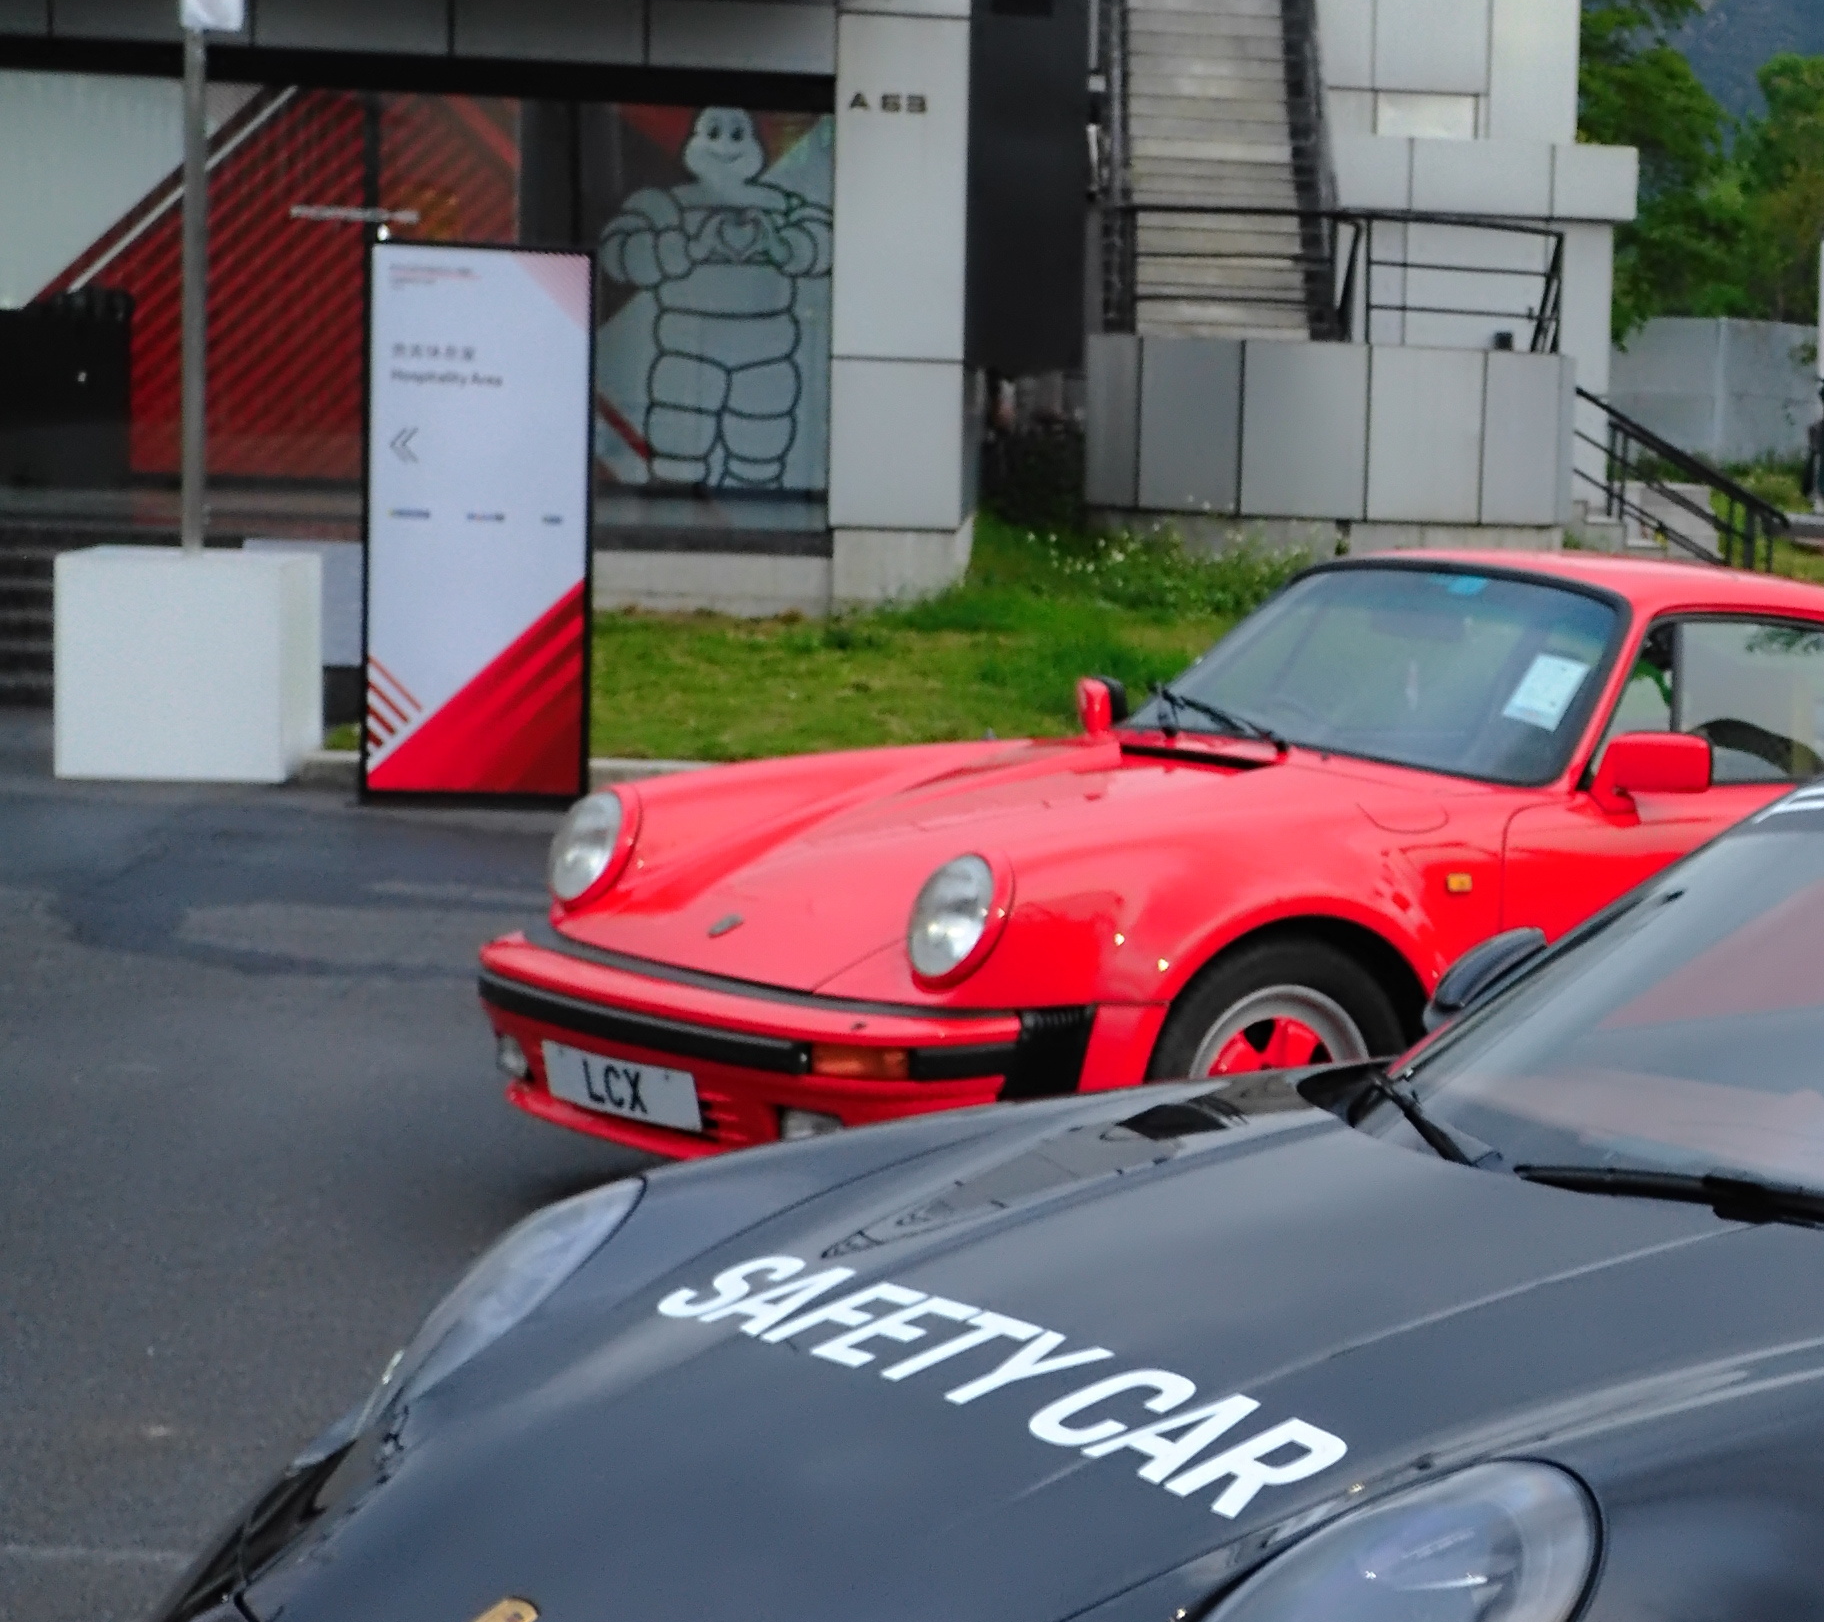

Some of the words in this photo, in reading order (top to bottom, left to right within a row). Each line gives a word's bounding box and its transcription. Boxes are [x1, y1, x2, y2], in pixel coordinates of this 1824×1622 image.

[581, 1056, 648, 1115] LCX
[657, 1254, 1115, 1405] SAFETY
[1028, 1367, 1349, 1519] CAR
